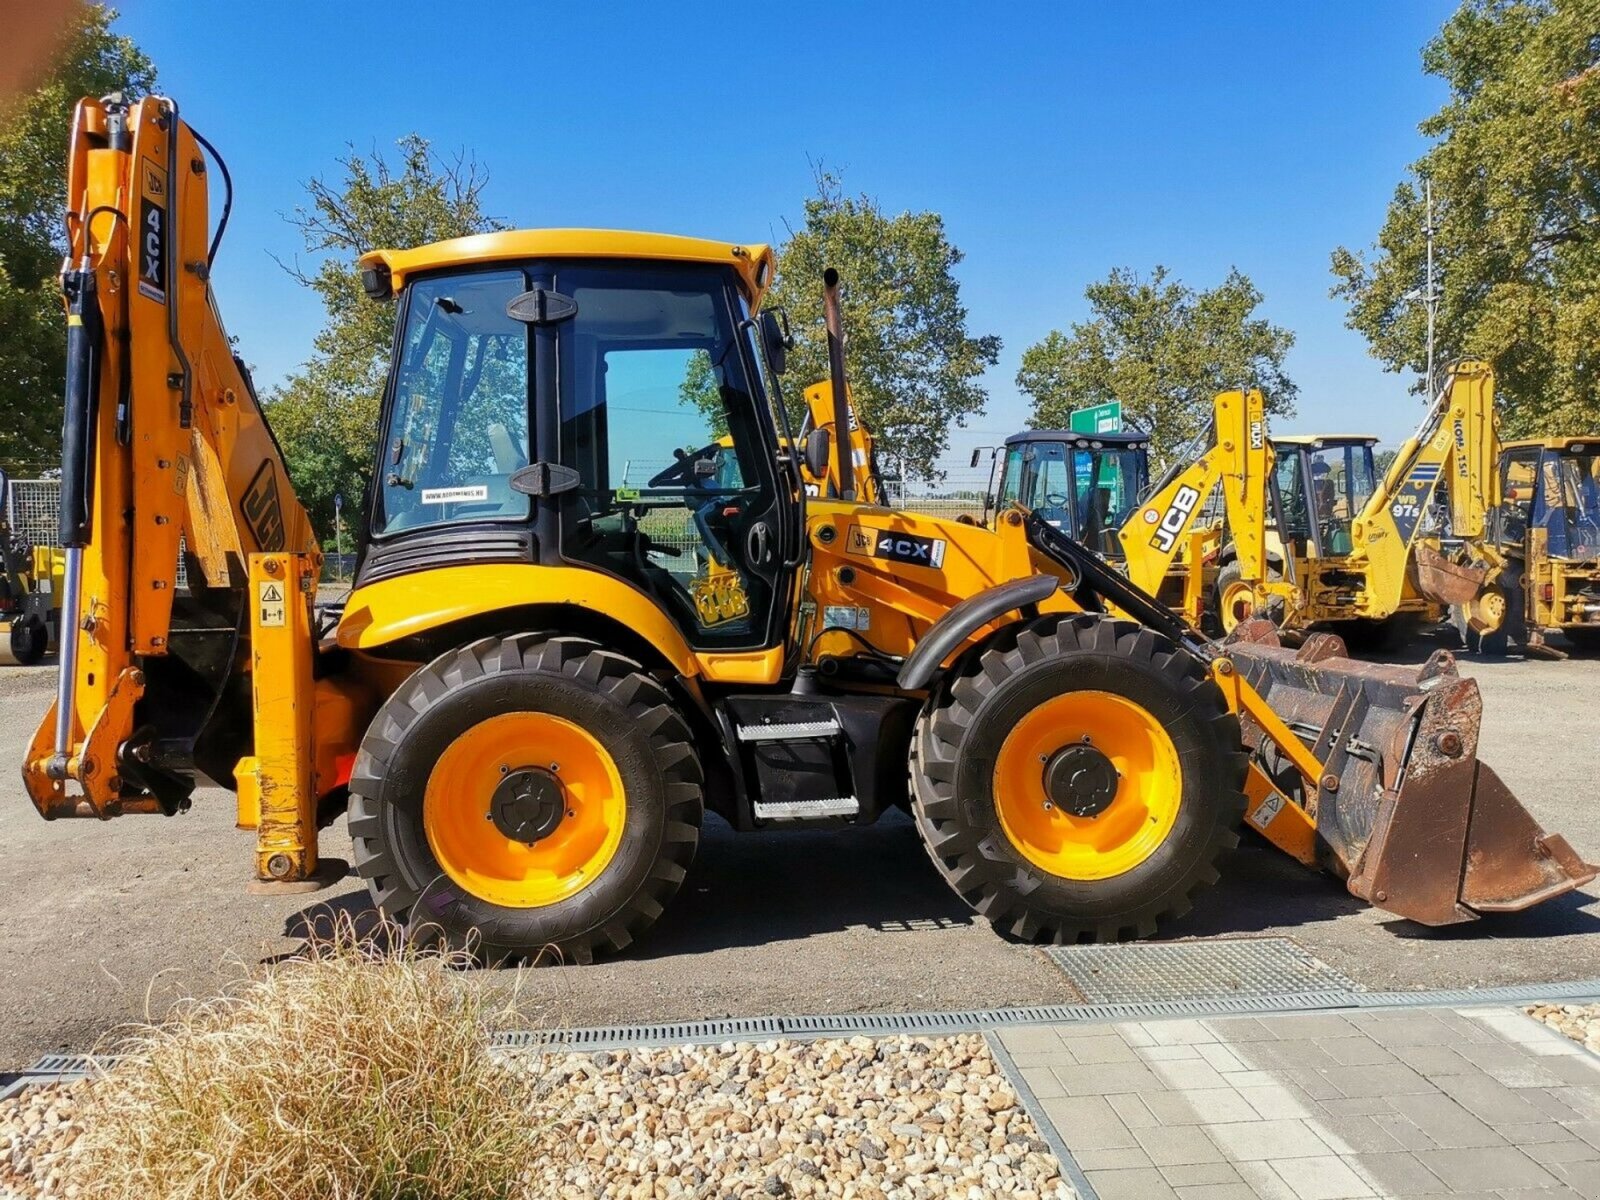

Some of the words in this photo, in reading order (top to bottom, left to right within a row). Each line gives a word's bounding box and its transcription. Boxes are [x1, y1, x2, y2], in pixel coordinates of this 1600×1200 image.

[146, 208, 161, 283] 4CX
[1156, 486, 1200, 551] JCB
[1397, 495, 1417, 505] WB
[878, 538, 929, 559] 4CX
